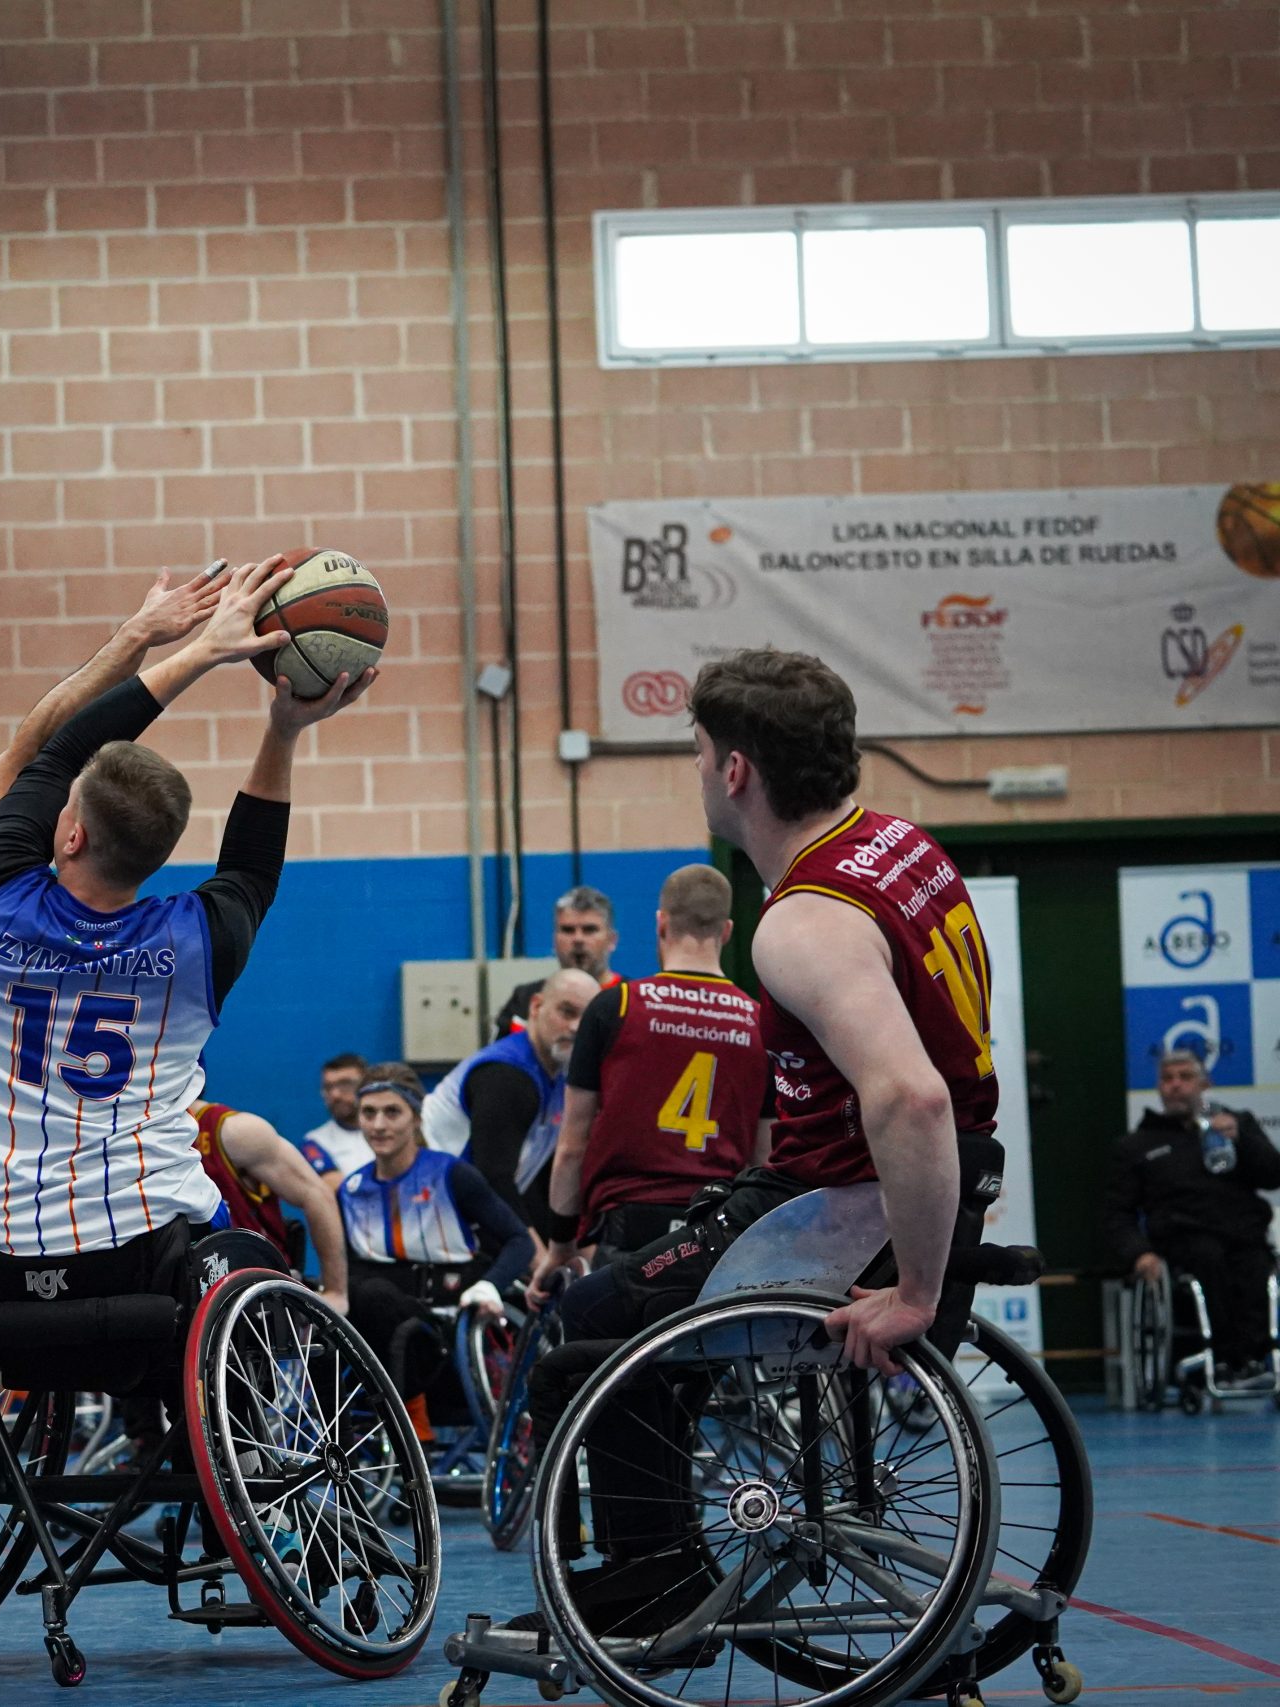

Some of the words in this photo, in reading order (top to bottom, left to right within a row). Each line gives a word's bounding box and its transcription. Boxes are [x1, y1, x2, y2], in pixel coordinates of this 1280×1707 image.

[832, 520, 889, 543] LIGA
[894, 516, 1016, 542] NACIONAL
[1023, 514, 1100, 538] FEDDF
[759, 548, 920, 572] BALONCESTO
[927, 548, 960, 569] EN
[968, 546, 1034, 568] SILLA
[1040, 544, 1072, 566] DE
[1078, 541, 1177, 564] RUEDAS
[640, 983, 754, 1013] Rehatrans
[923, 901, 995, 1081] 10
[645, 1000, 697, 1015] Transporte
[5, 981, 141, 1102] 15
[650, 1018, 751, 1047] fundaciónfdi
[657, 1051, 718, 1152] 4
[25, 1269, 69, 1299] RGK
